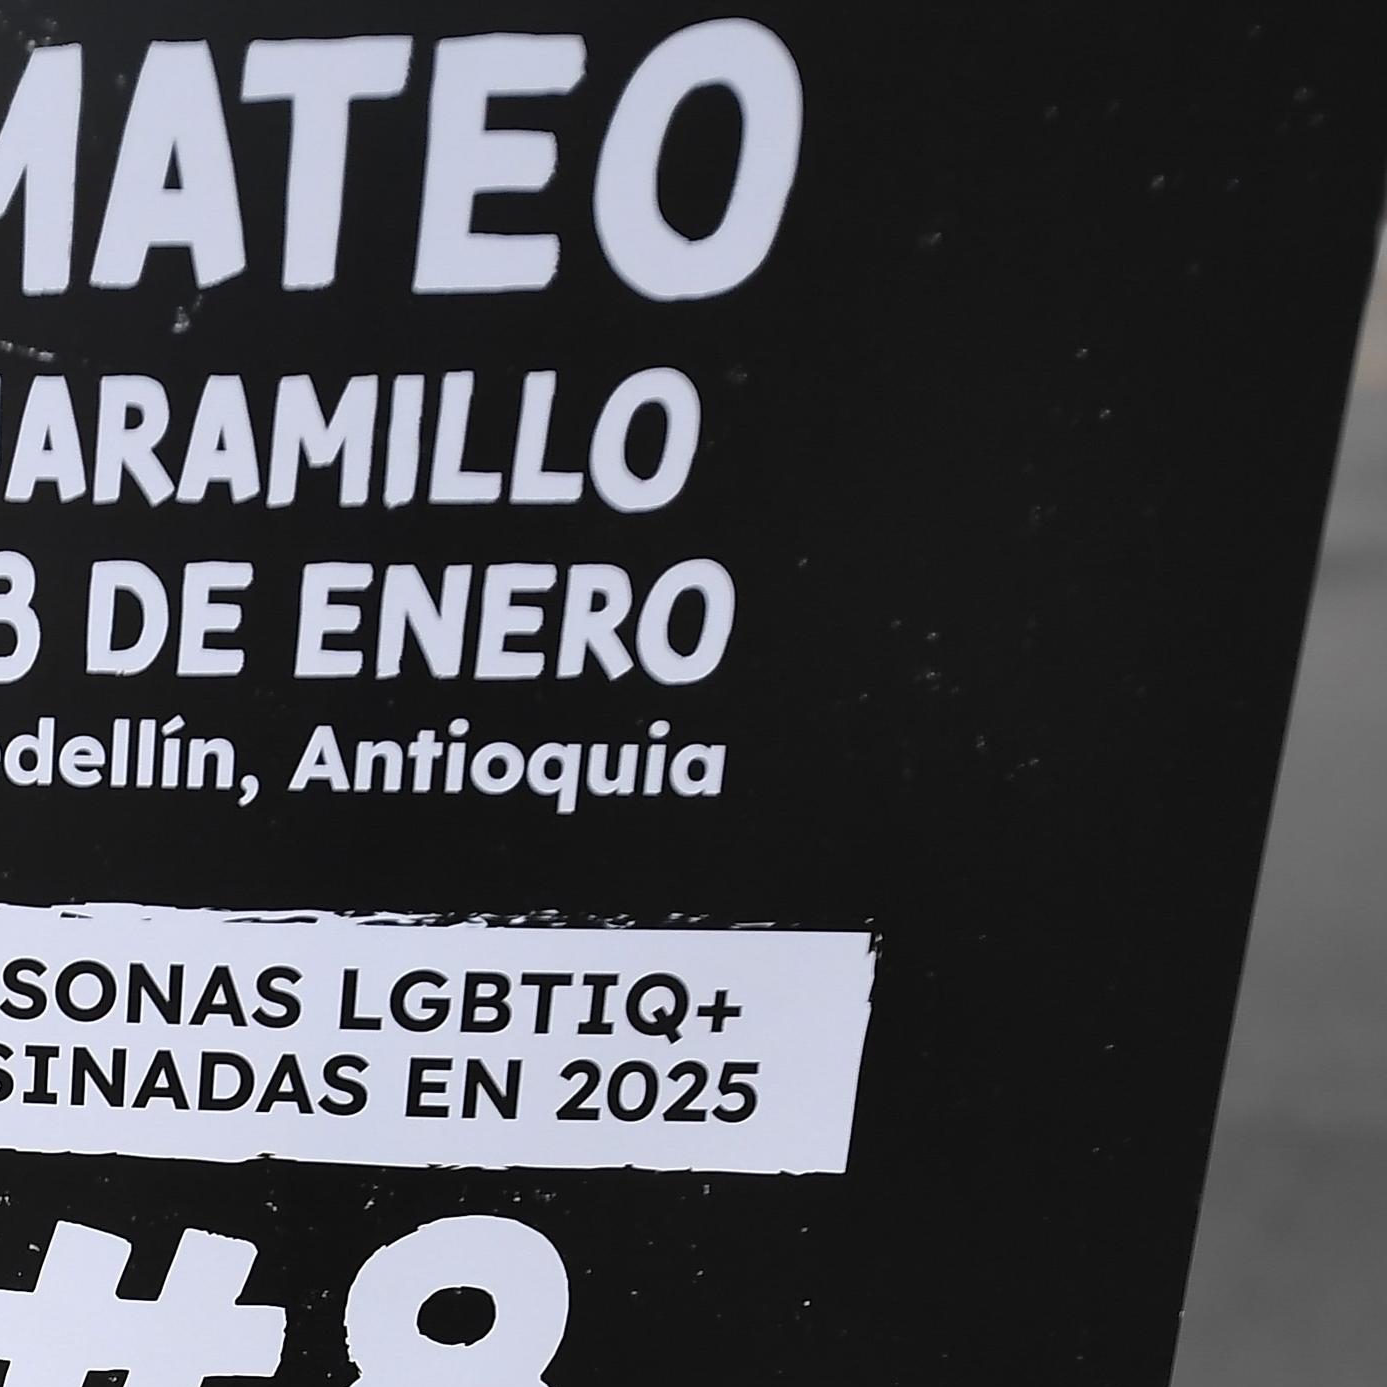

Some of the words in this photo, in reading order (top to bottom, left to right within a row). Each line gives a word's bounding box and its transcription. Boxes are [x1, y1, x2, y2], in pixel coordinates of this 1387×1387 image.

[86, 560, 253, 677] DE
[294, 558, 735, 685] ENERO
[288, 718, 726, 814] Antioquia
[339, 968, 742, 1045] LGBTIQ+
[405, 1057, 522, 1120] EN
[555, 1059, 760, 1123] 2025
